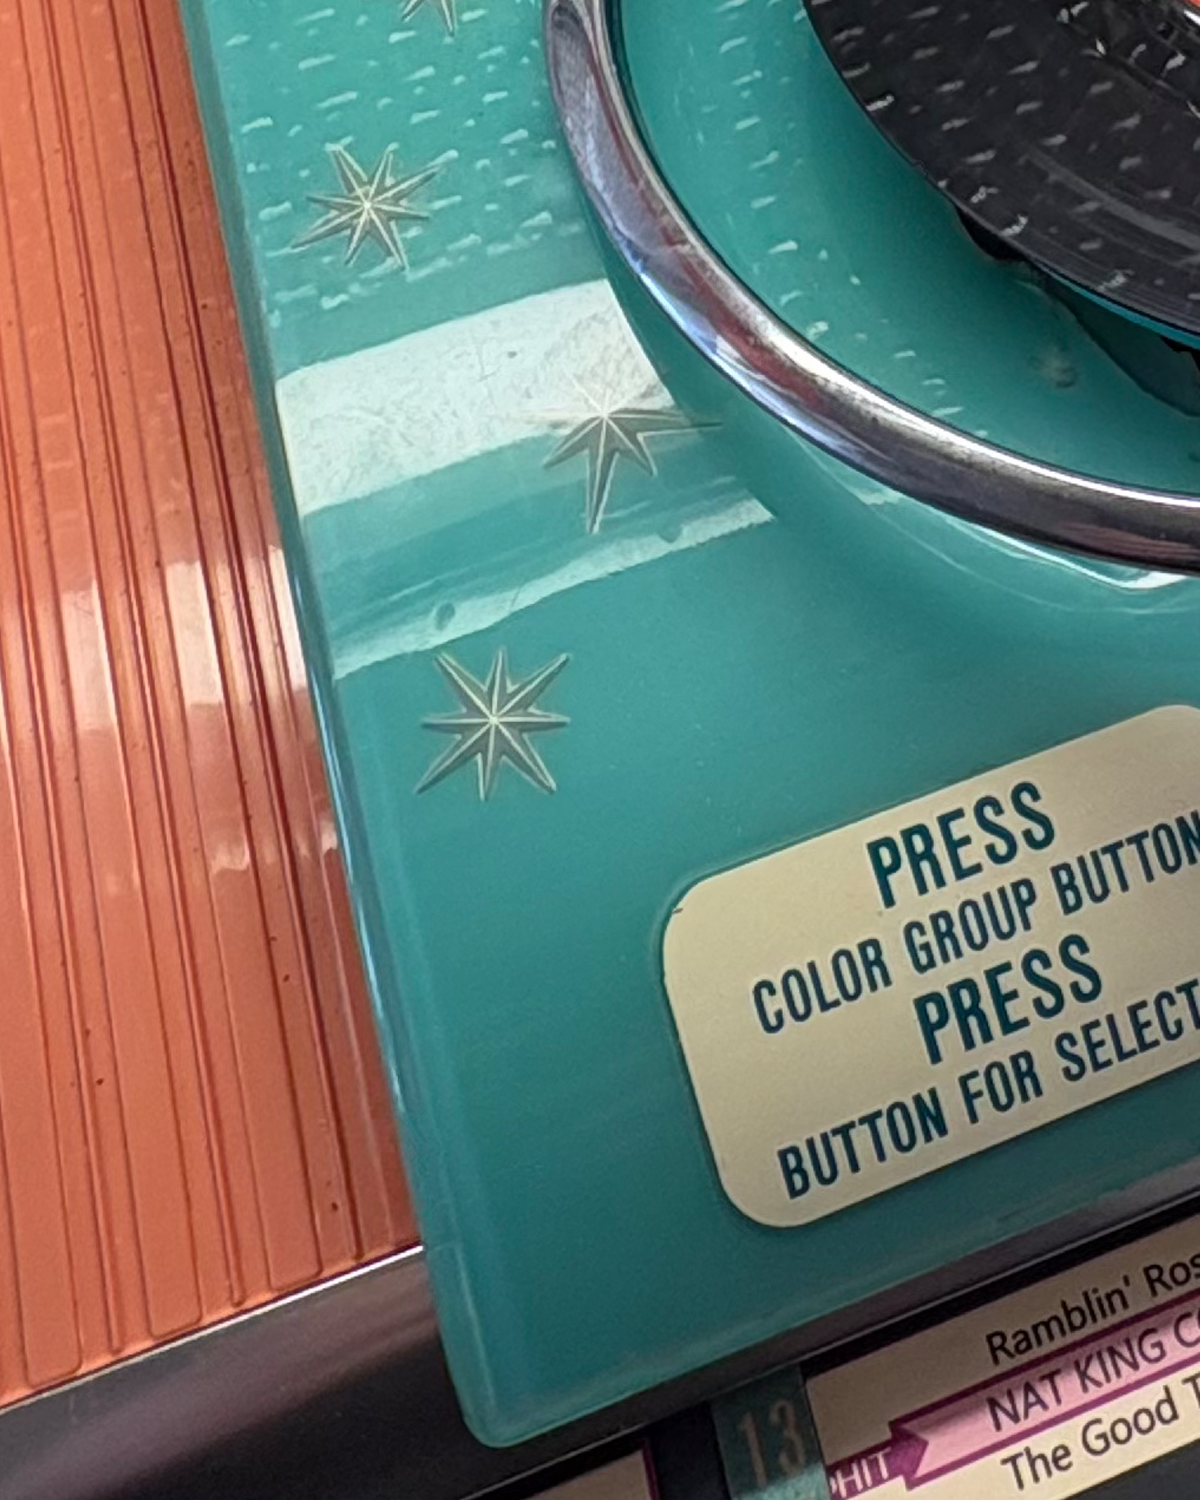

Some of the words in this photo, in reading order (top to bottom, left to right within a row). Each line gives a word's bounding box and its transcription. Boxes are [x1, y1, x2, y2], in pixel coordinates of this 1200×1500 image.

[867, 781, 1057, 909] PRESS
[752, 937, 891, 1035] COLOR
[904, 877, 1037, 975] GROUP
[913, 933, 1103, 1066] PRESS
[777, 1087, 947, 1200] BUTTON
[960, 1050, 1043, 1124] FOR
[984, 1279, 1133, 1367] Ramblin'
[984, 1371, 1065, 1433] NAT
[1073, 1326, 1168, 1394] KING
[735, 1399, 807, 1487] 13
[1000, 1441, 1073, 1492] The
[1081, 1386, 1180, 1456] Good
